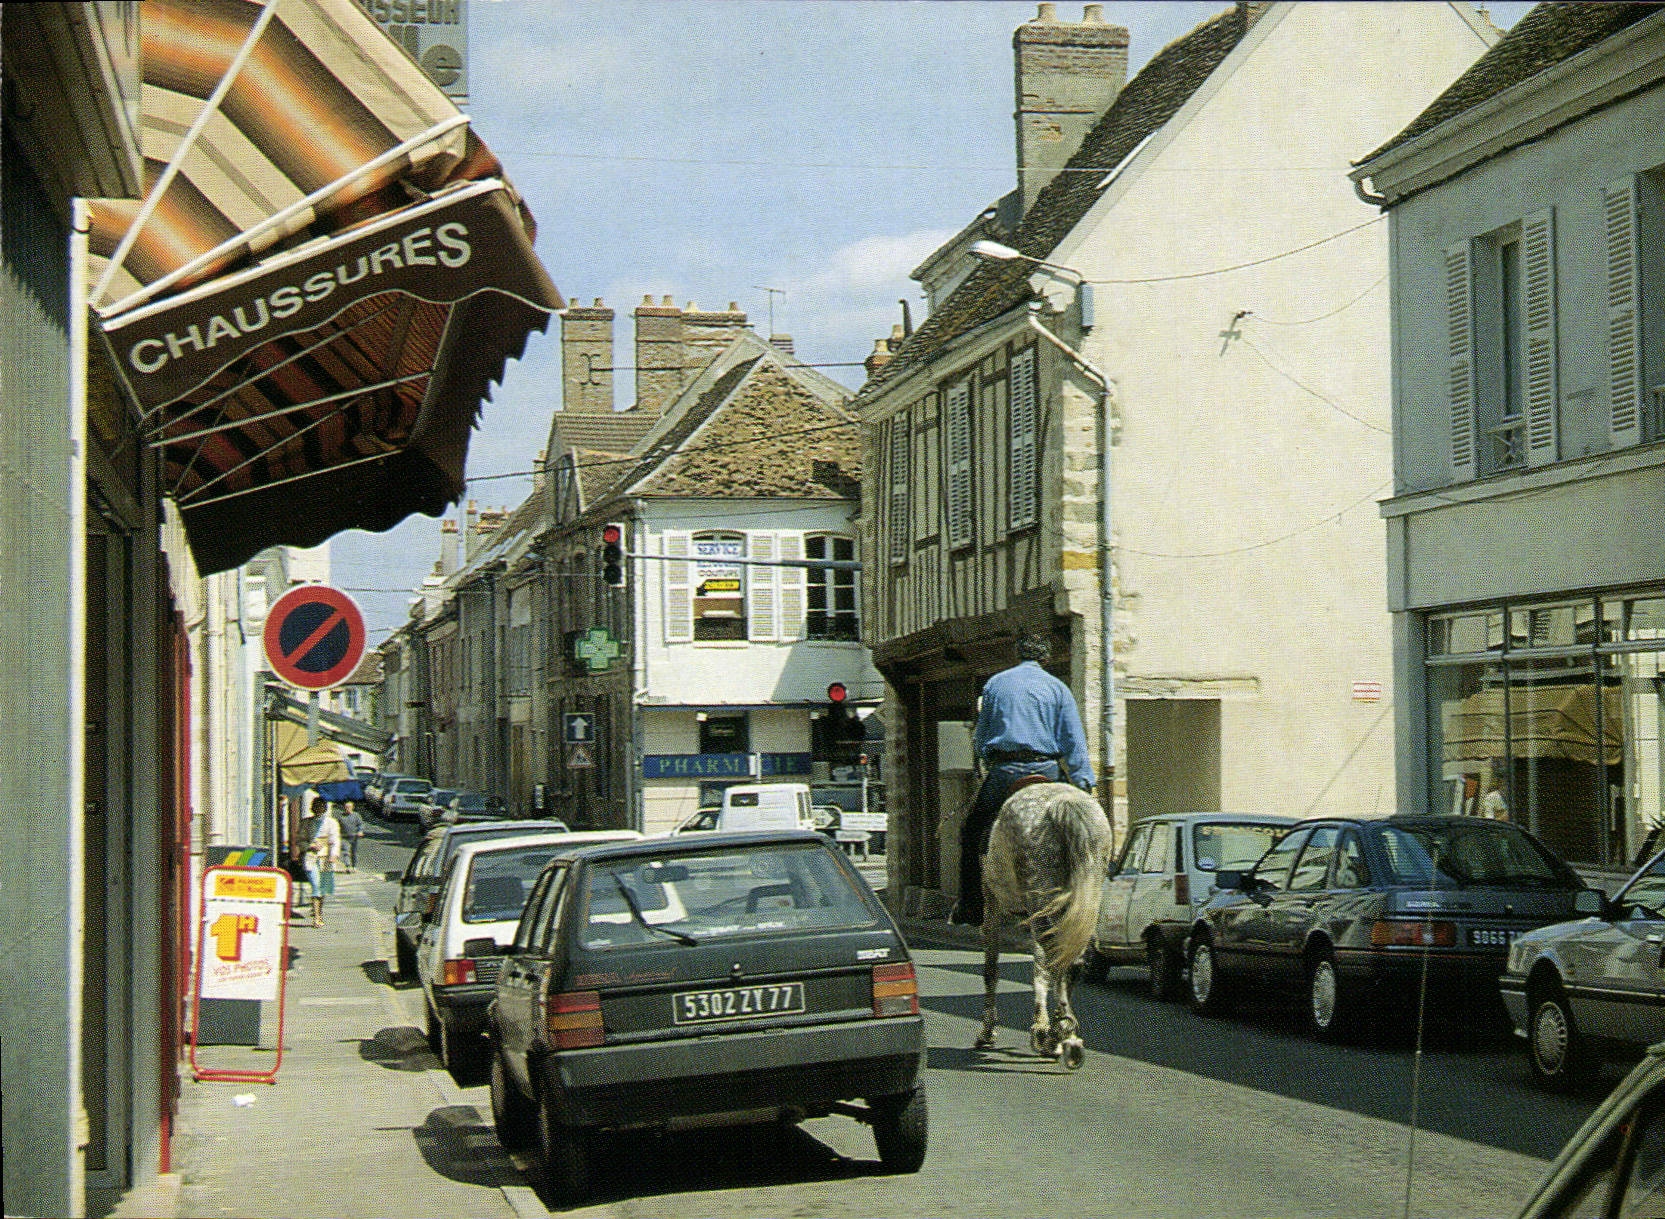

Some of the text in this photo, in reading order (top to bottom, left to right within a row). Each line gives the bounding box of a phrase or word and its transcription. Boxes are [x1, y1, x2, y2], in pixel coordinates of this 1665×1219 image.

[128, 221, 473, 374] CHAUSSURES
[658, 756, 799, 775] PHARMCIE
[684, 986, 793, 1019] 5302 ZY 77
